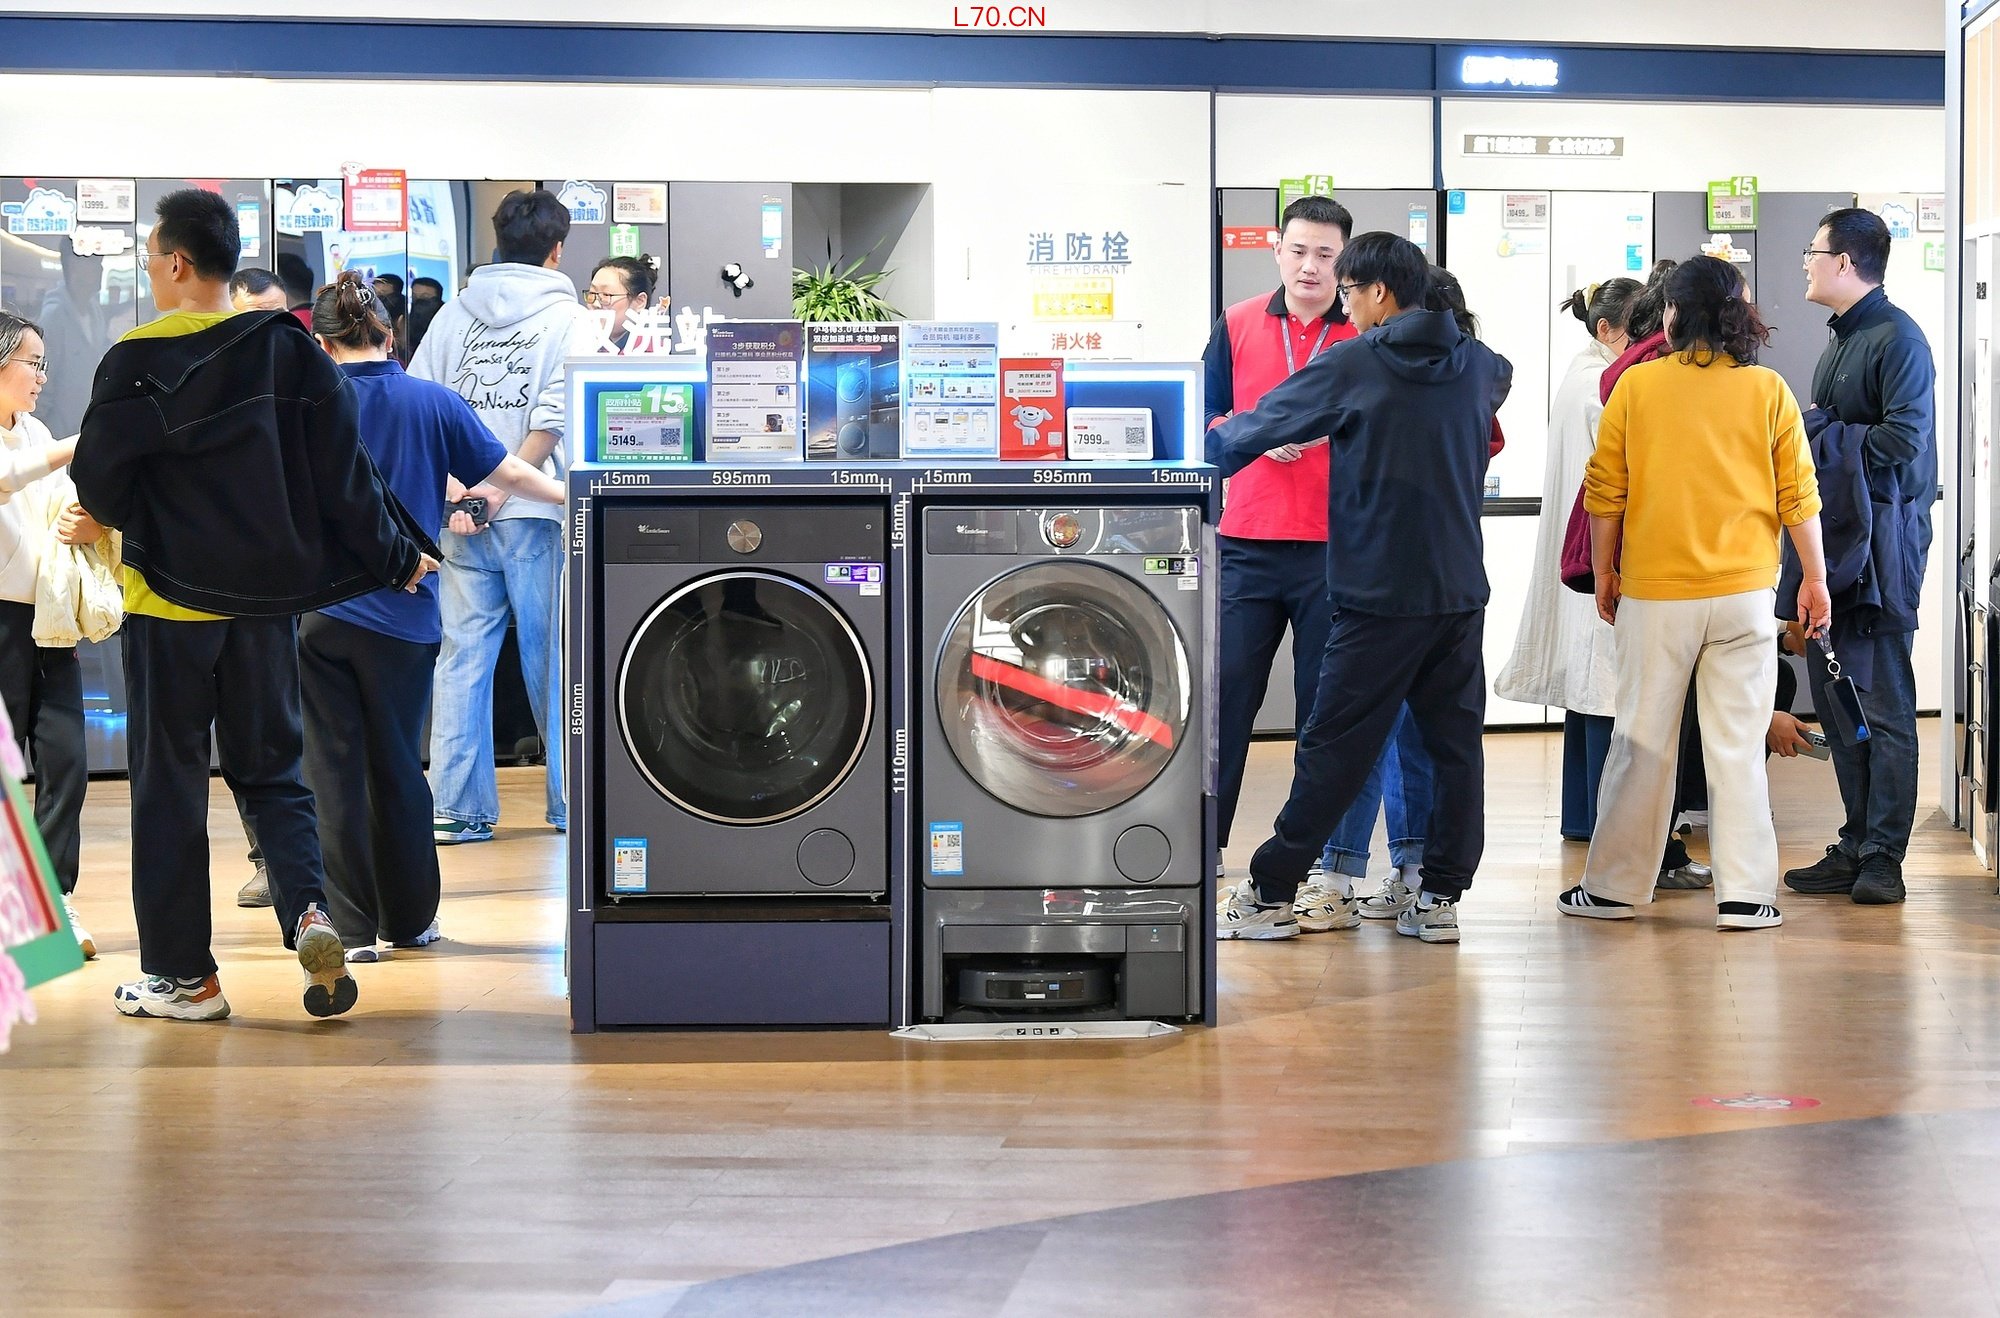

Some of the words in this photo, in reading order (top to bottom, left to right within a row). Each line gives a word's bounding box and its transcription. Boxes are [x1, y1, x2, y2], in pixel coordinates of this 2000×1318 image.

[1029, 232, 1129, 261] 消防栓
[1030, 265, 1059, 275] FIRE
[1065, 264, 1127, 275] HYDRANT
[1052, 332, 1102, 350] 消火栓
[647, 386, 689, 413] 15%
[602, 471, 650, 485] 15mm
[712, 471, 771, 485] 595mm
[830, 470, 879, 484] 15mm
[923, 470, 972, 483] 15mm
[1033, 470, 1092, 483] 595mm
[1151, 469, 1199, 483] 15mm
[573, 511, 584, 556] 15mm
[892, 503, 904, 550] 15mm
[571, 682, 583, 735] 850mm
[893, 728, 906, 794] 1110mm
